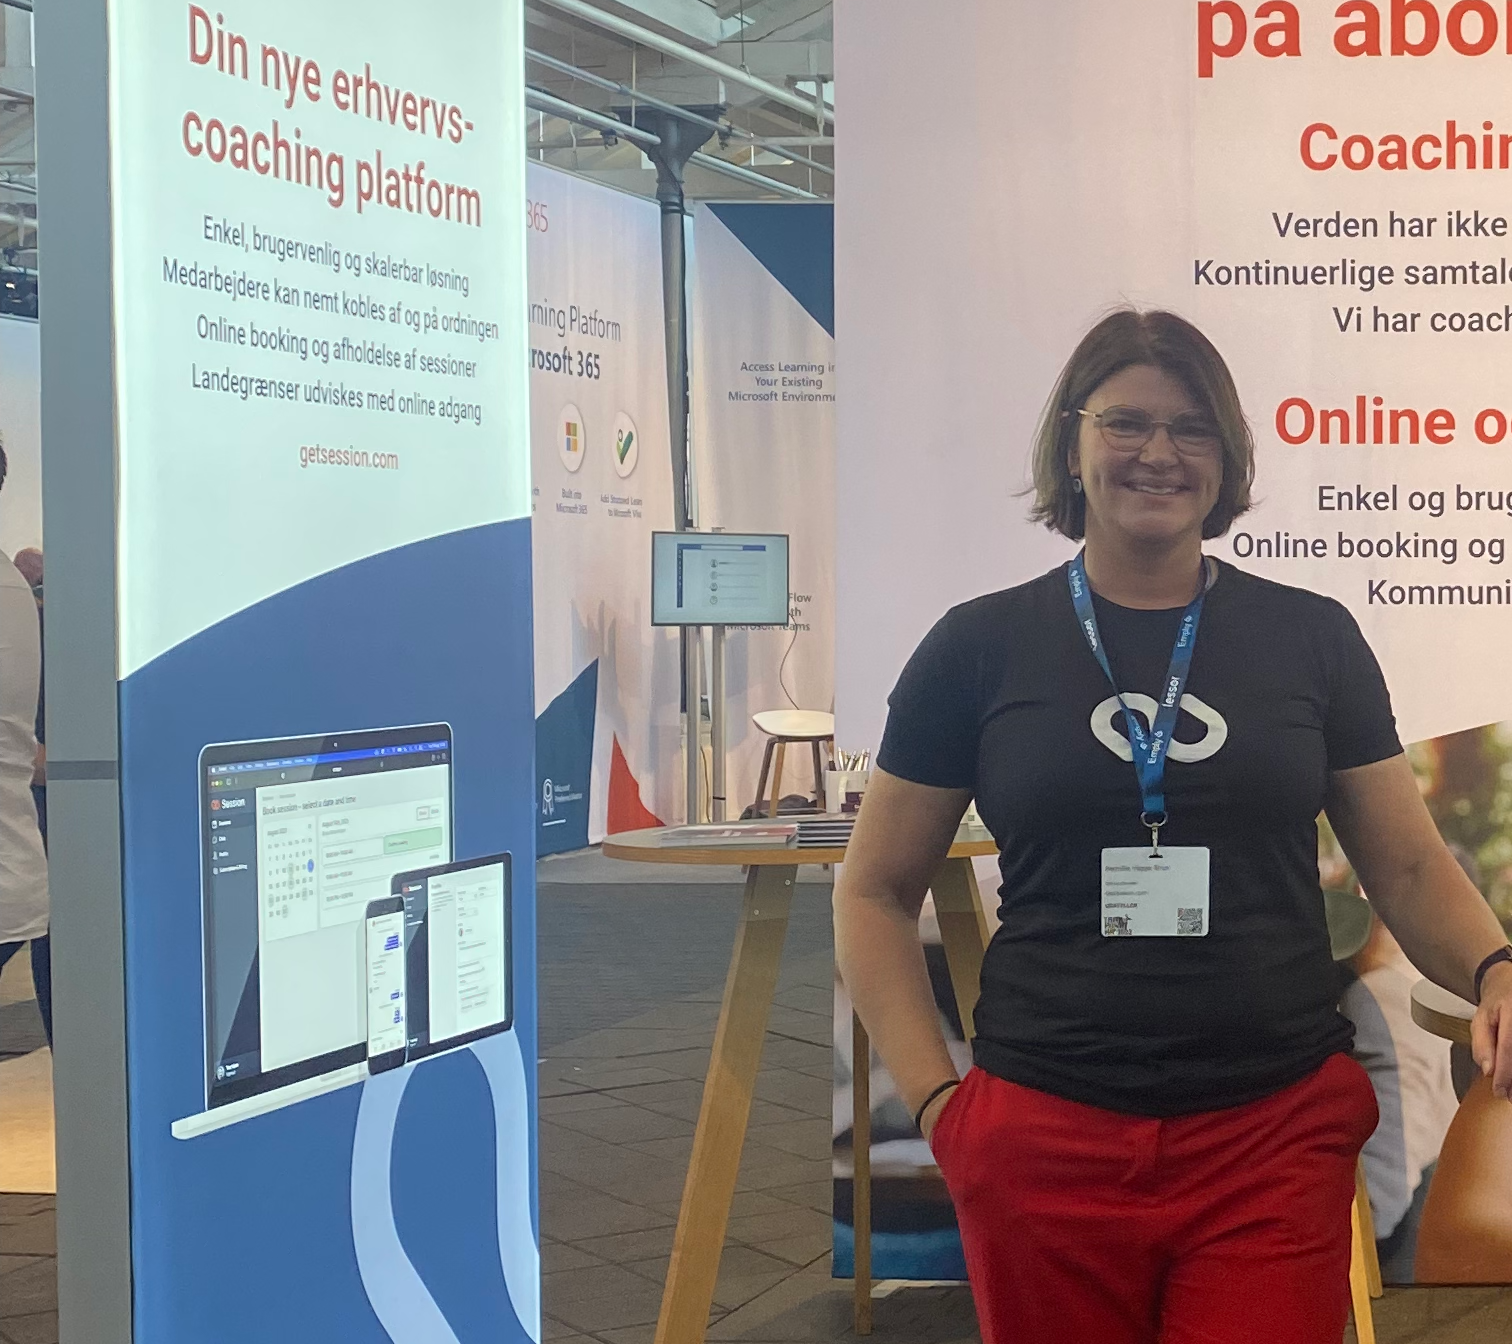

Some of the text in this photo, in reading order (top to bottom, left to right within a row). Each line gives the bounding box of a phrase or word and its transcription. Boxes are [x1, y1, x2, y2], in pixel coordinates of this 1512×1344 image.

[188, 3, 474, 143] Din nye erhvervs-
[182, 111, 481, 226] coaching platform
[1272, 211, 1378, 238] Verden
[1389, 211, 1437, 237] har
[1447, 210, 1507, 237] ikke
[203, 214, 469, 298] Enkel, brugervenlig og skalerbar løsning
[1195, 258, 1394, 292] Kontinuerlige
[163, 256, 499, 343] Medarbejdere kan nemt kobles af og på ordningen
[528, 298, 621, 342] rning Platform
[1332, 306, 1361, 332] Vi
[1373, 306, 1421, 332] har
[197, 313, 477, 378] Online booking og afholdelse af sessioner
[531, 345, 601, 380] rosoft 365
[740, 362, 775, 372] Access
[779, 362, 825, 375] Learning
[755, 377, 823, 390] Your Existing
[192, 362, 482, 426] Landegrænser udviskes med online adgang
[728, 391, 778, 402] Microsoft
[1276, 395, 1455, 445] Online
[299, 439, 399, 471] getsession.com
[1319, 484, 1397, 511] Enkel
[1409, 492, 1444, 517] og
[1233, 532, 1327, 559] Online
[1338, 531, 1457, 564] booking
[1468, 539, 1504, 564] og
